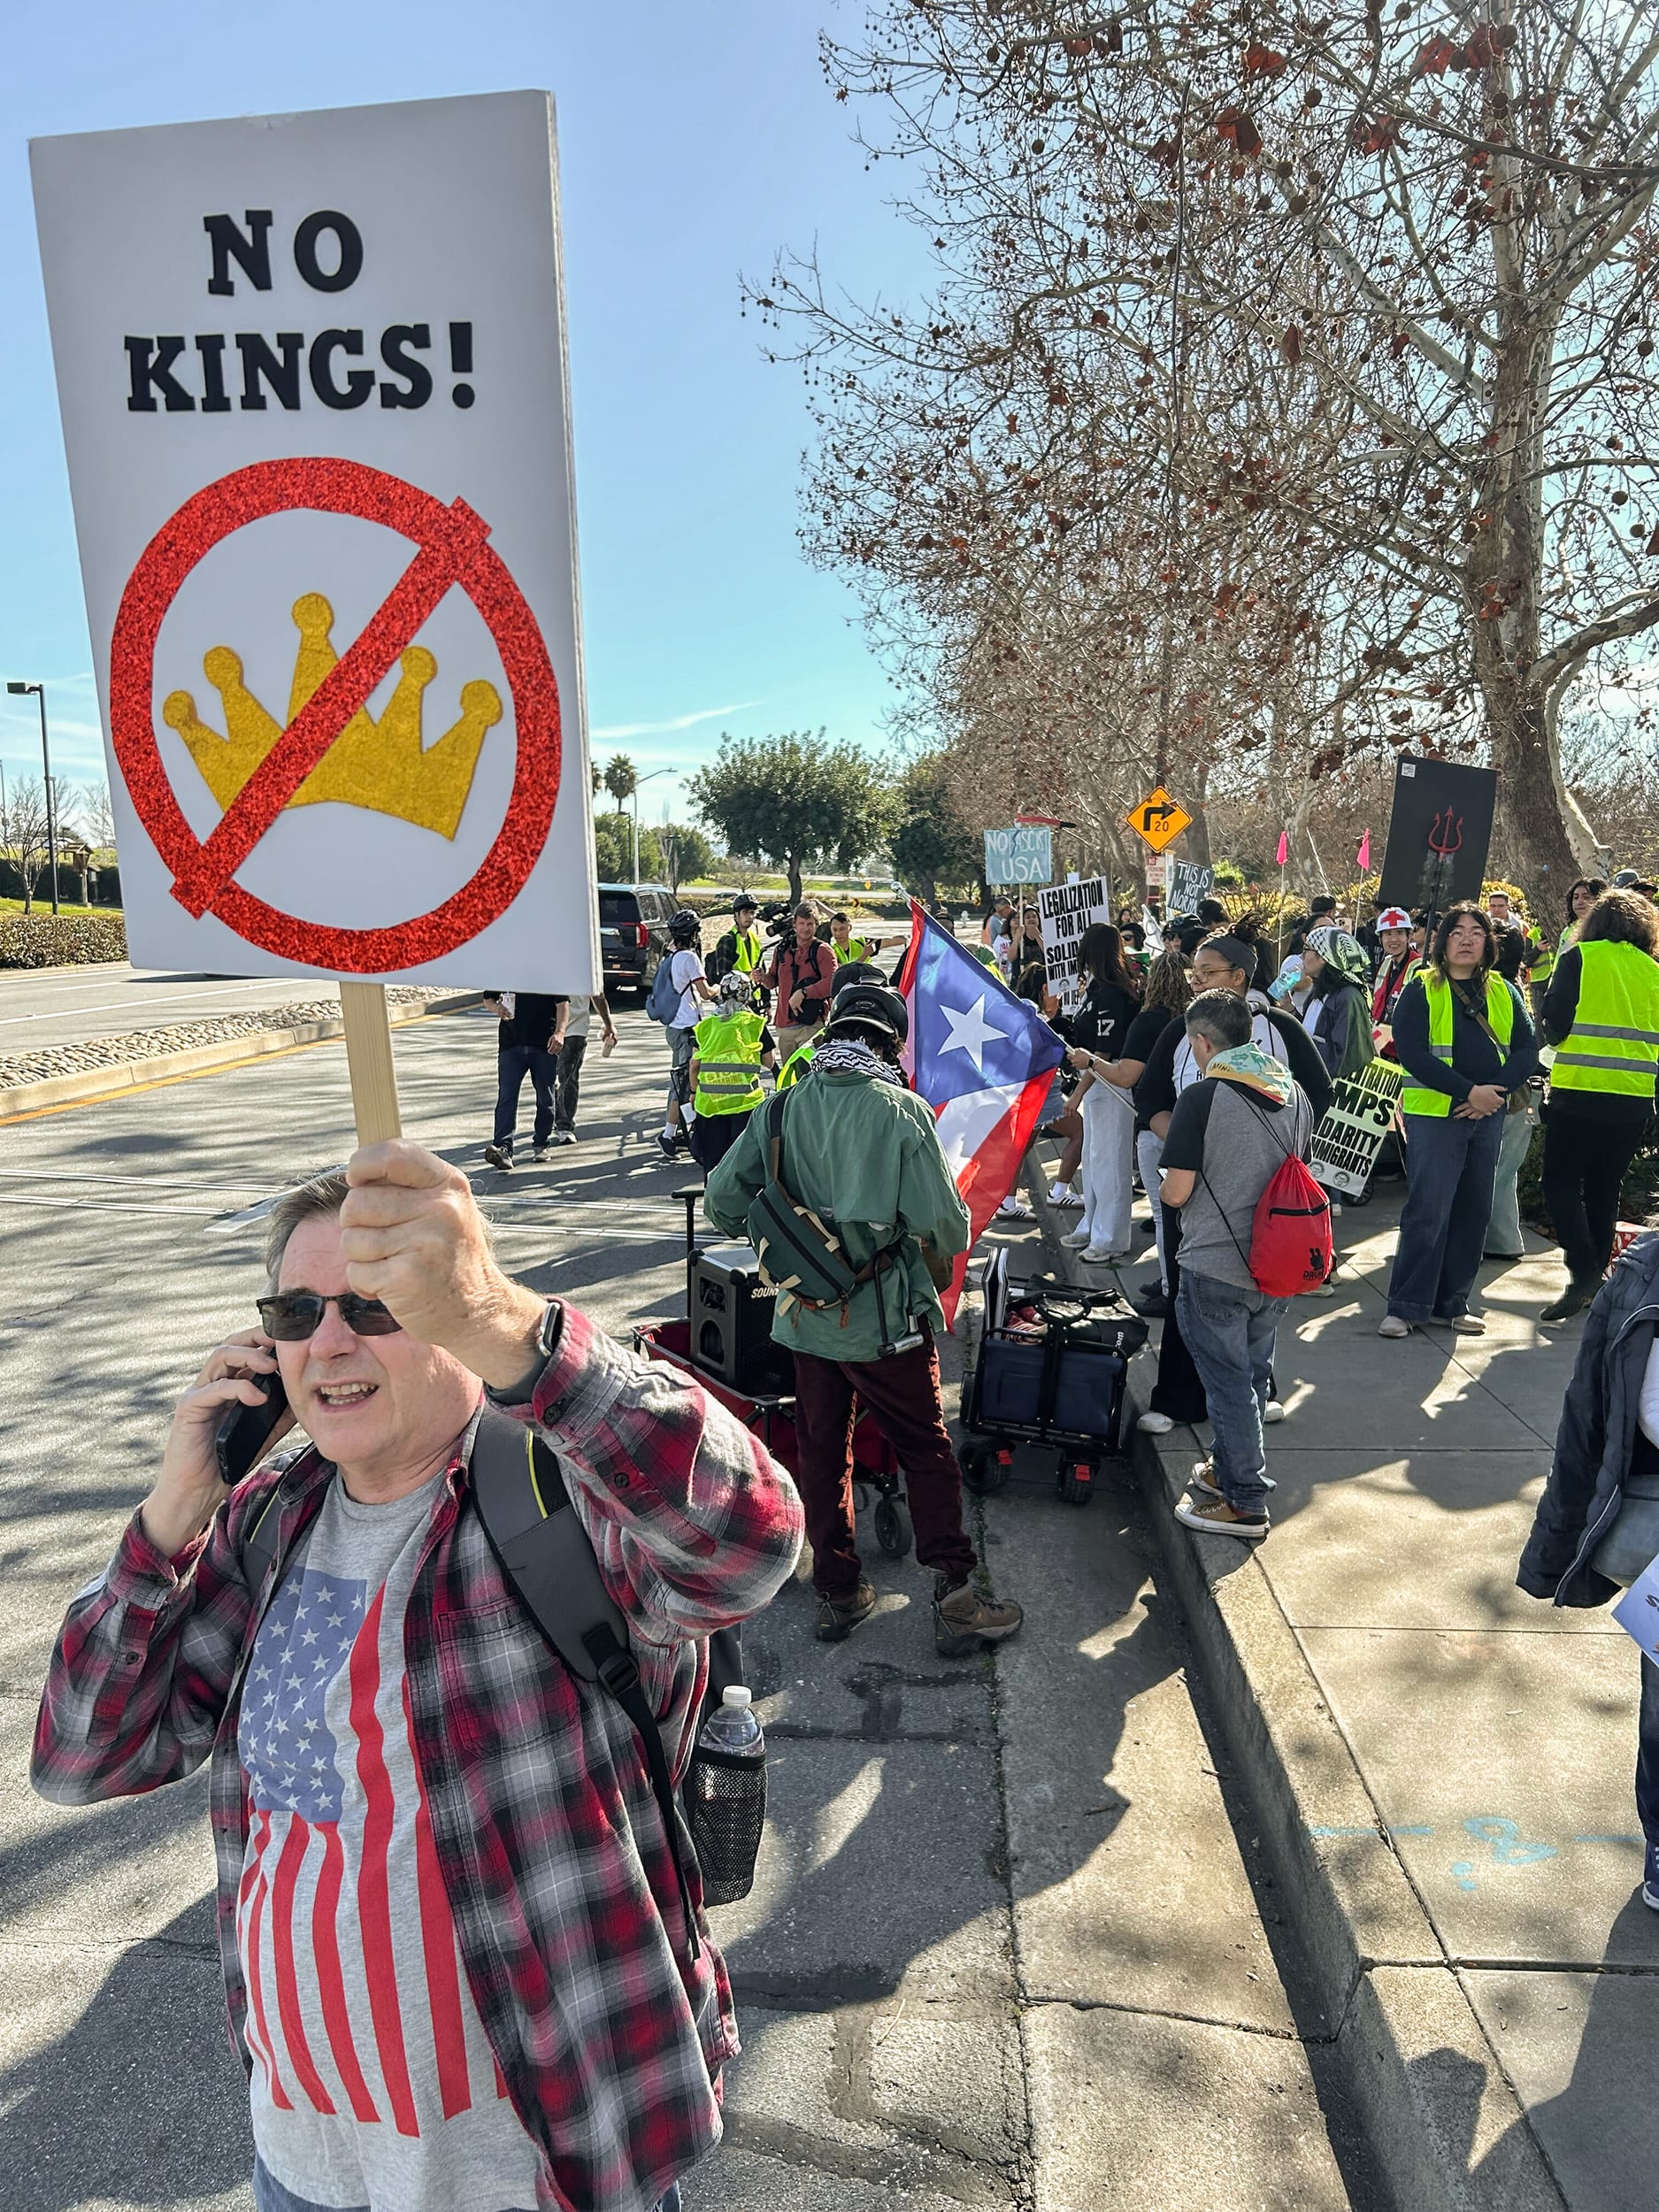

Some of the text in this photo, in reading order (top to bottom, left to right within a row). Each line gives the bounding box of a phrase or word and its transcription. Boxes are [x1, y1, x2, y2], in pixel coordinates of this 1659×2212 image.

[203, 209, 364, 296] NO
[124, 321, 476, 412] KINGS!
[1155, 820, 1169, 832] 20
[987, 832, 1008, 856] NO
[1002, 856, 1044, 882] USA
[1177, 862, 1199, 884] THIS
[1199, 868, 1210, 888] IS
[1041, 879, 1104, 919] LEGALIZATION
[1170, 889, 1198, 915] NORMA
[1183, 882, 1202, 898] NOT
[1056, 910, 1091, 939] FOR ALL
[1046, 941, 1079, 964] SOLID
[1048, 962, 1066, 981] WITH
[1097, 1018, 1115, 1036] 17
[1333, 1080, 1394, 1126] MPS
[1318, 1115, 1382, 1157] DARITY
[1311, 1136, 1372, 1178] MMIGRANTS
